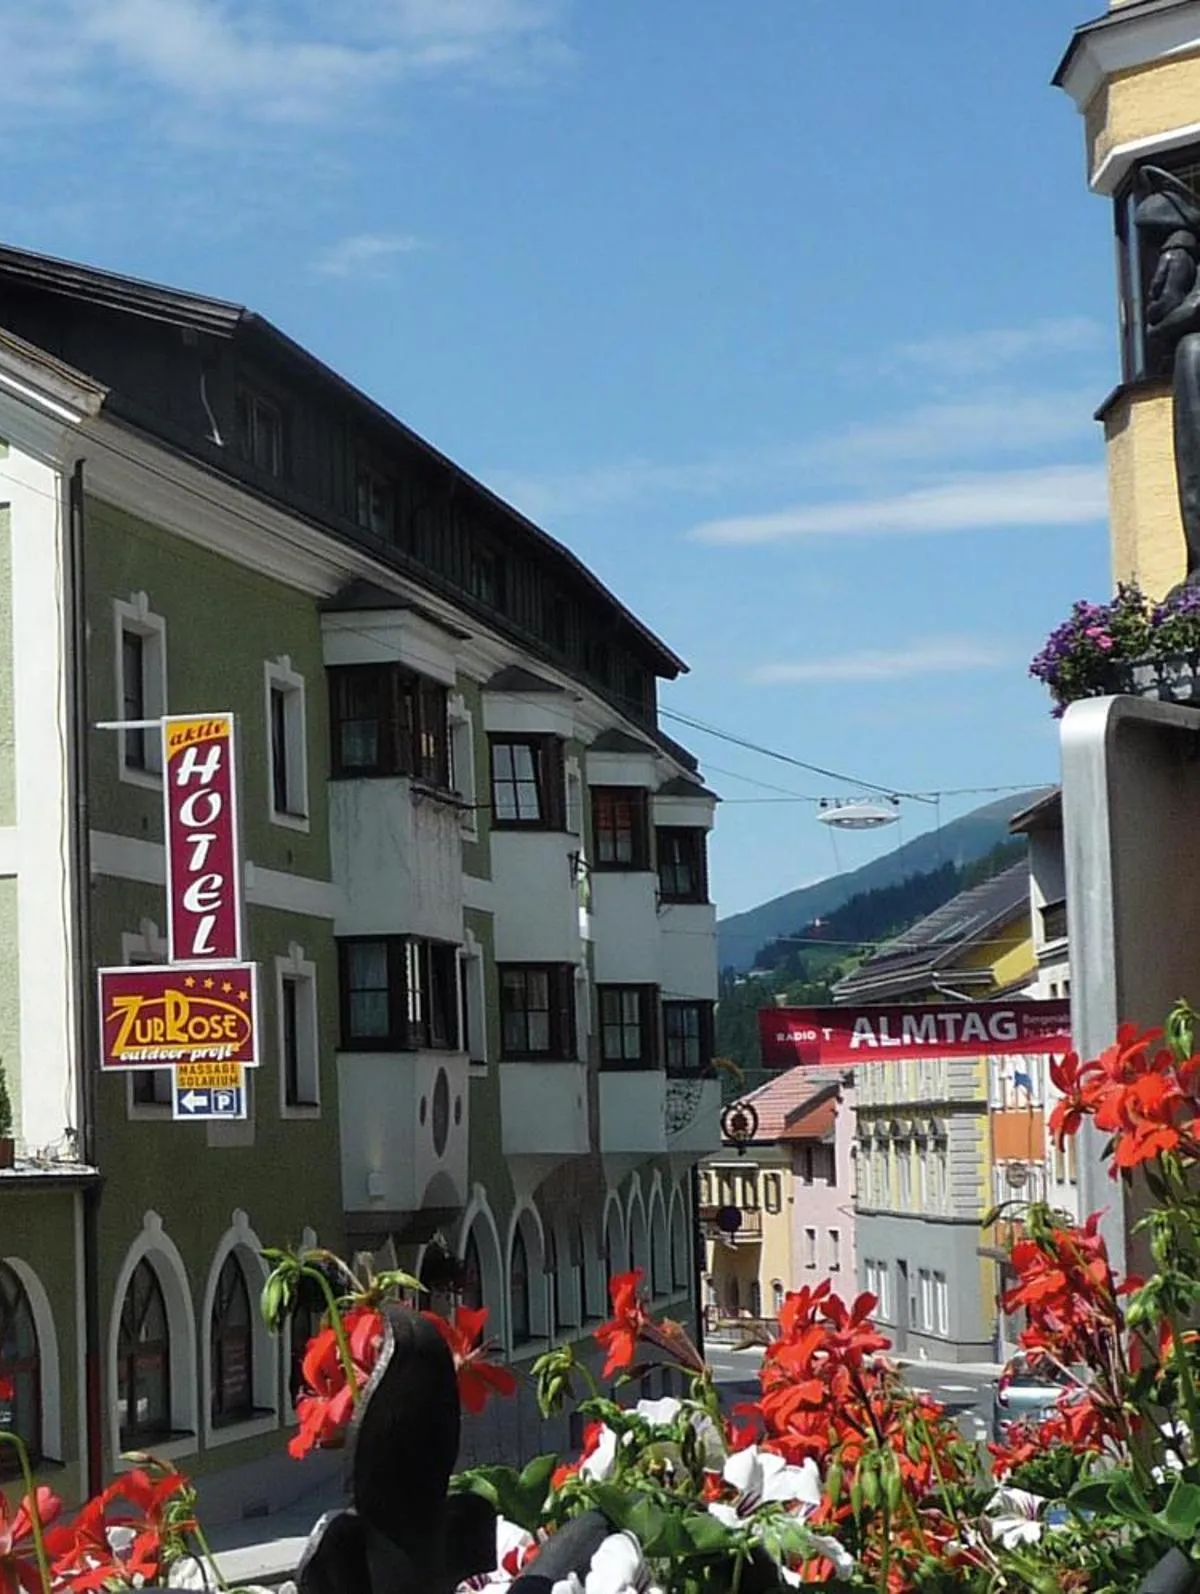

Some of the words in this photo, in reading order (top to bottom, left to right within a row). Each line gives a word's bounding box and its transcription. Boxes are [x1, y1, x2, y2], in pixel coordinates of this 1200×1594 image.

[176, 744, 224, 955] HOTEL
[776, 1030, 817, 1041] RADIO
[822, 1027, 833, 1041] T
[849, 1011, 1018, 1049] ALMTAG
[179, 1063, 235, 1075] MASSAGE
[179, 1075, 238, 1087] SOLARIUM
[218, 1095, 230, 1110] P
